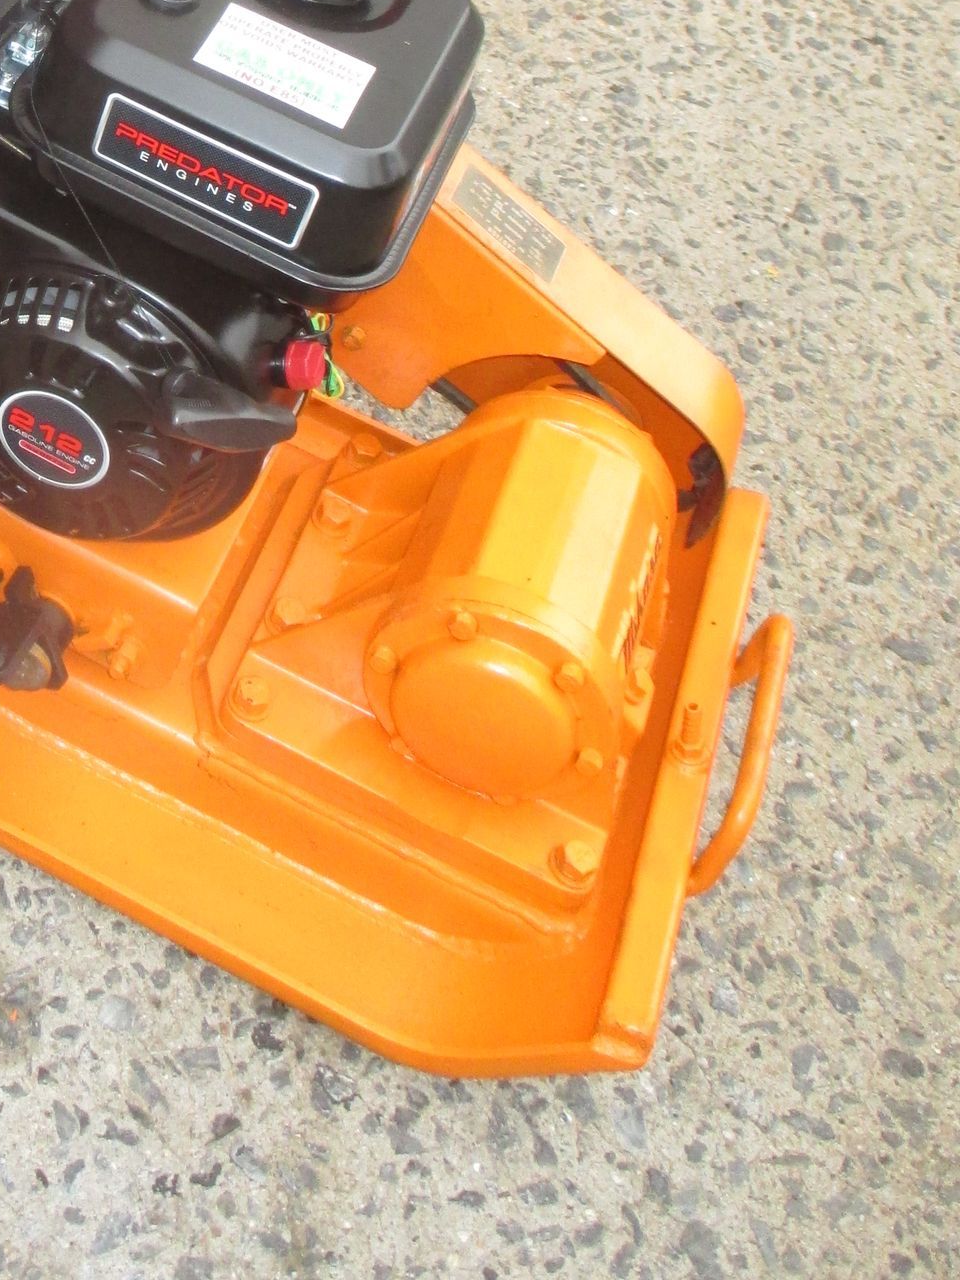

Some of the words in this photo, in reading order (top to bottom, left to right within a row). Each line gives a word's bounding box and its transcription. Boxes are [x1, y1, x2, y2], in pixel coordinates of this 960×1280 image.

[227, 15, 290, 46] OPERATE
[292, 43, 363, 79] PROPERLY
[241, 29, 282, 51] VOIDS
[286, 49, 363, 88] WARRANTY
[260, 20, 296, 39] USER
[300, 38, 338, 58] MUST
[138, 150, 254, 212] ENGINES
[7, 423, 53, 452] GASOLINE
[55, 449, 90, 471] ENGINE
[9, 407, 82, 455] 212
